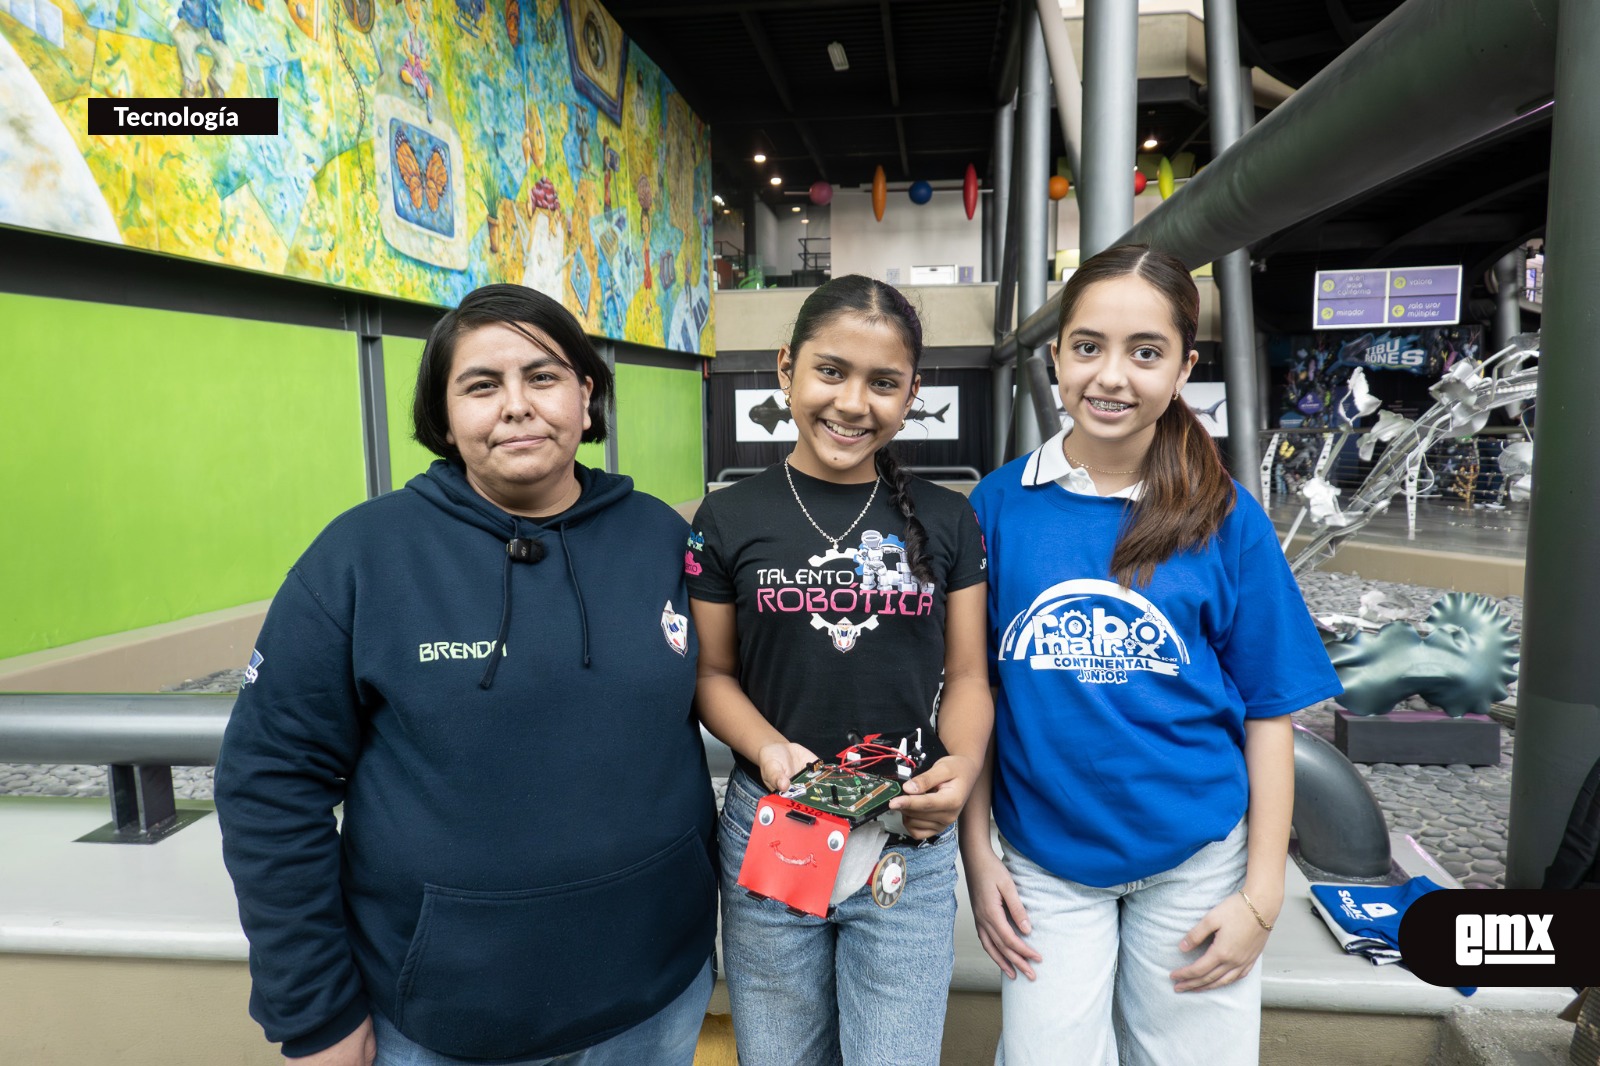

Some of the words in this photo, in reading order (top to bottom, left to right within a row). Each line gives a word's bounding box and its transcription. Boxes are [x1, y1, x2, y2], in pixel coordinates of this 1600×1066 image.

[1336, 308, 1365, 317] mirador
[1365, 337, 1400, 355] TIBU
[757, 568, 855, 585] TALENTO
[757, 582, 933, 616] ROBÓTICA
[1032, 608, 1168, 646] robo
[1034, 635, 1161, 660] matrix
[1054, 657, 1154, 669] CONTINENTAL
